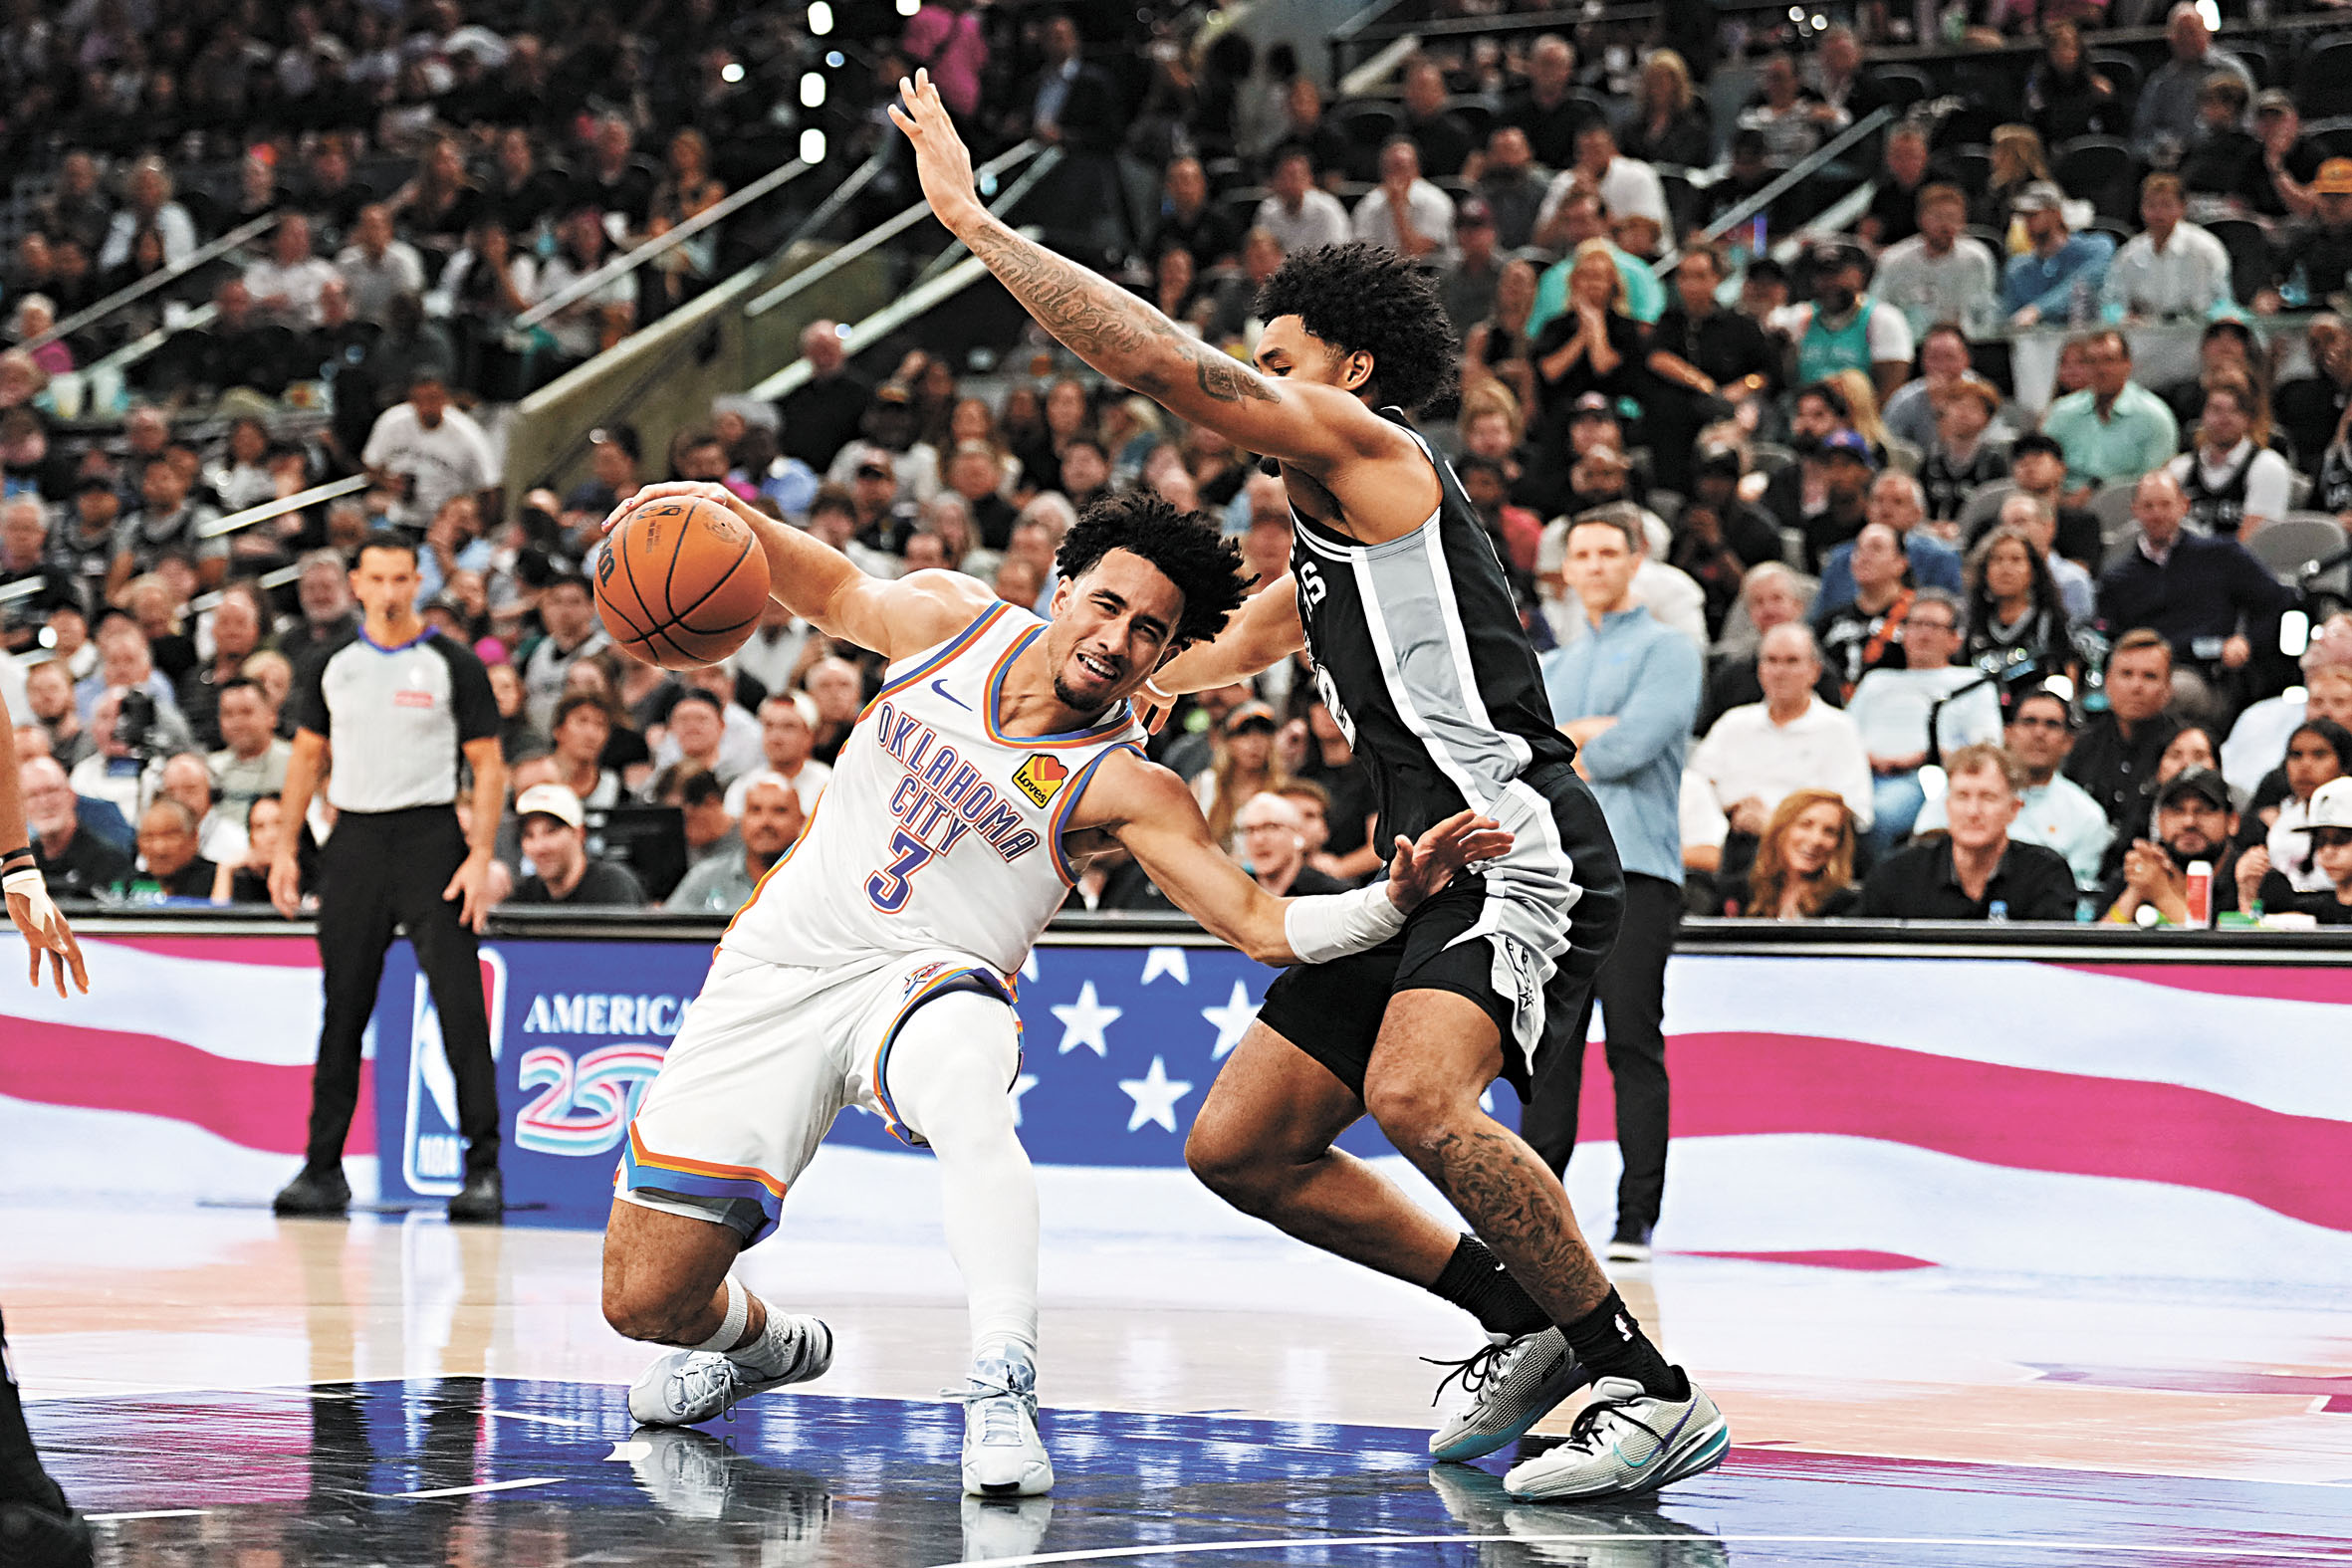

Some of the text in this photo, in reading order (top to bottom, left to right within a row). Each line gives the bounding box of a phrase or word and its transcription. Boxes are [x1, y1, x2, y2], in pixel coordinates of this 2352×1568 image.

[878, 702, 1040, 863] OKLAHOMA
[889, 775, 971, 857] CITY
[864, 825, 936, 915] 3
